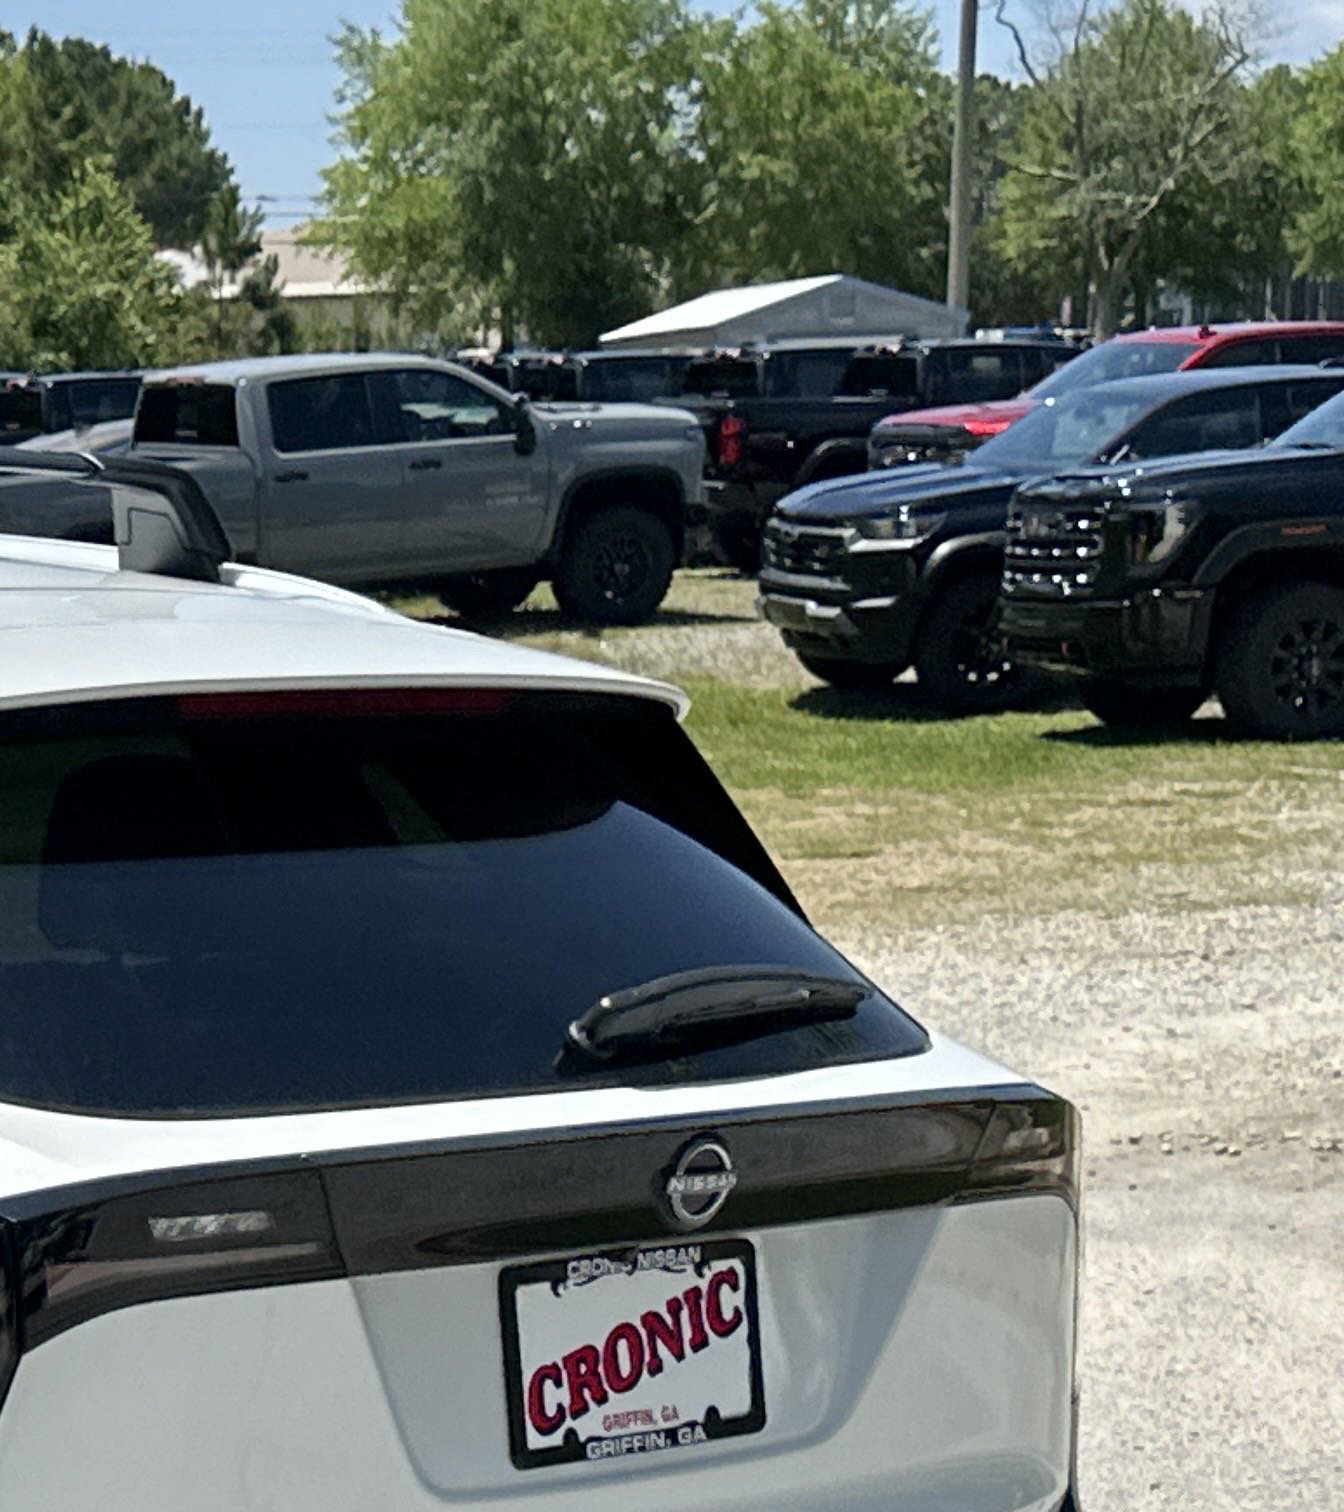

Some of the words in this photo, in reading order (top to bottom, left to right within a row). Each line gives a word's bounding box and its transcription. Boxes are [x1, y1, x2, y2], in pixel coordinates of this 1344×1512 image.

[637, 1246, 701, 1268] NISSAN
[528, 1266, 743, 1436] CRONIC
[586, 1431, 672, 1459] GRIFFIN,
[677, 1424, 707, 1445] GA
